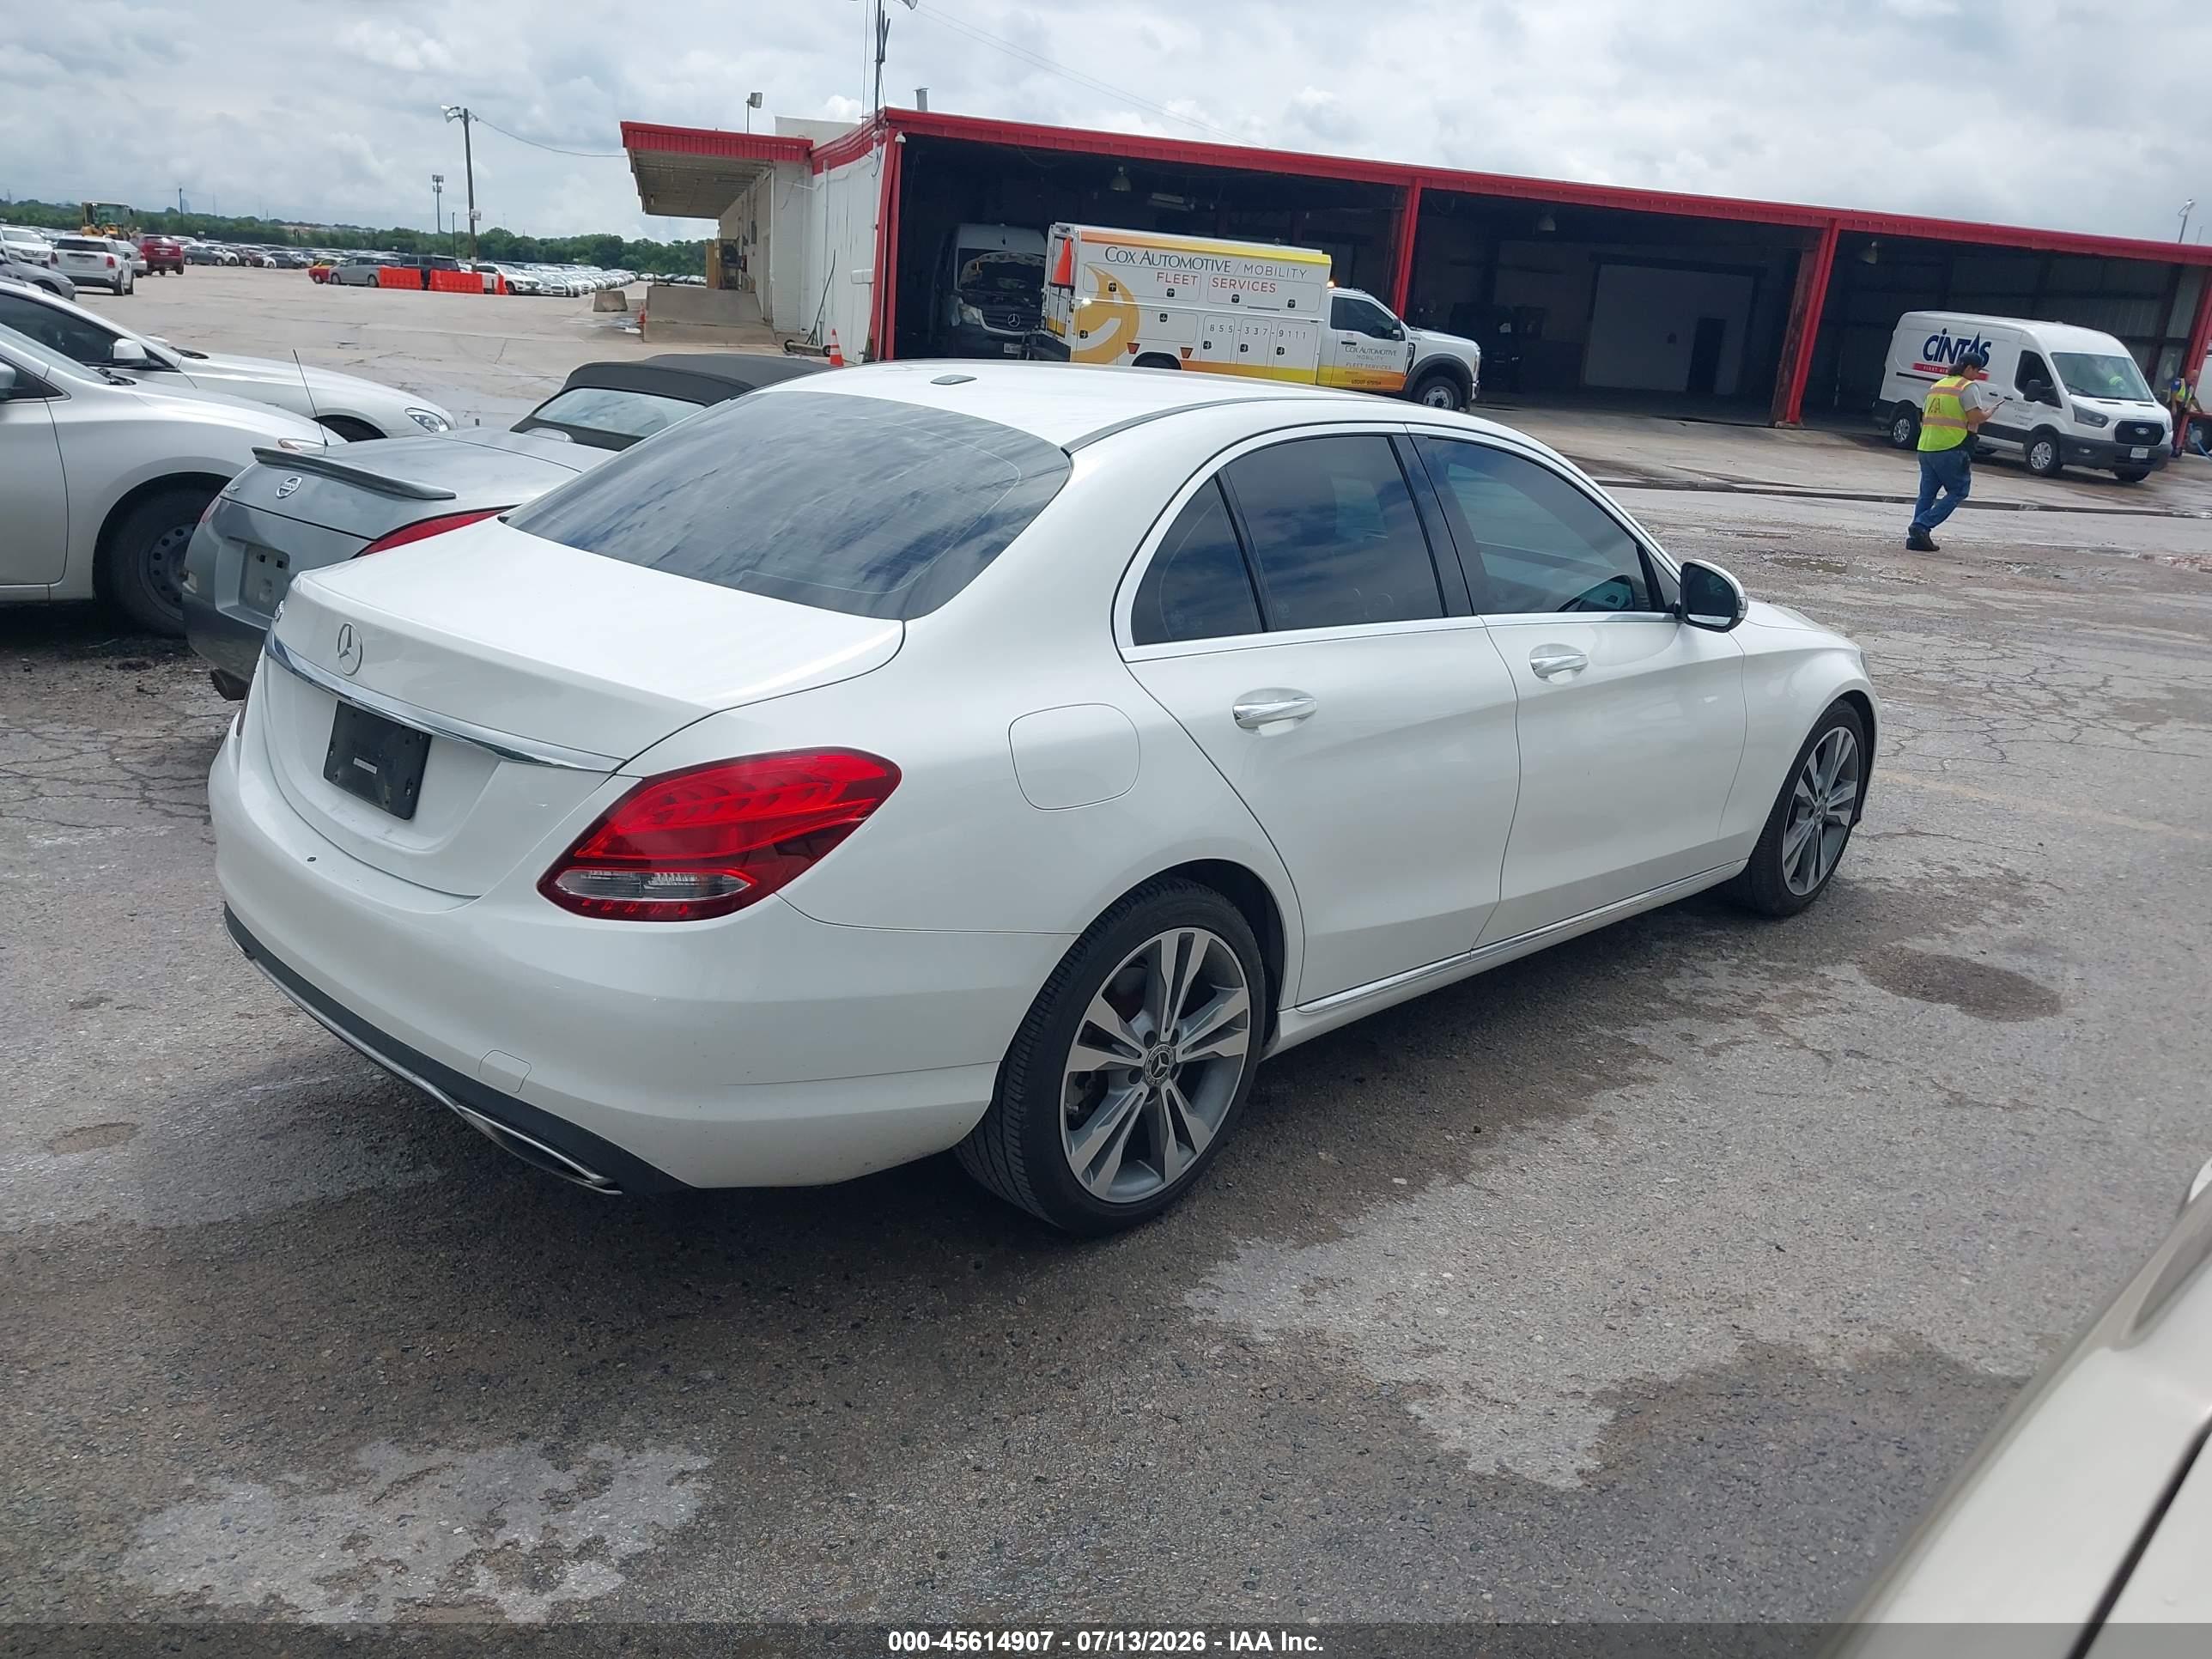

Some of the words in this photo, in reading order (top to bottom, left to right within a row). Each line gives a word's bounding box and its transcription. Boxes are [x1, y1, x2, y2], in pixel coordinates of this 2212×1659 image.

[1139, 249, 1231, 274] AUTOMOTIVE
[1243, 264, 1308, 280] MOBILITY
[1157, 271, 1199, 287] FLEET
[1212, 276, 1277, 294] SERVICES
